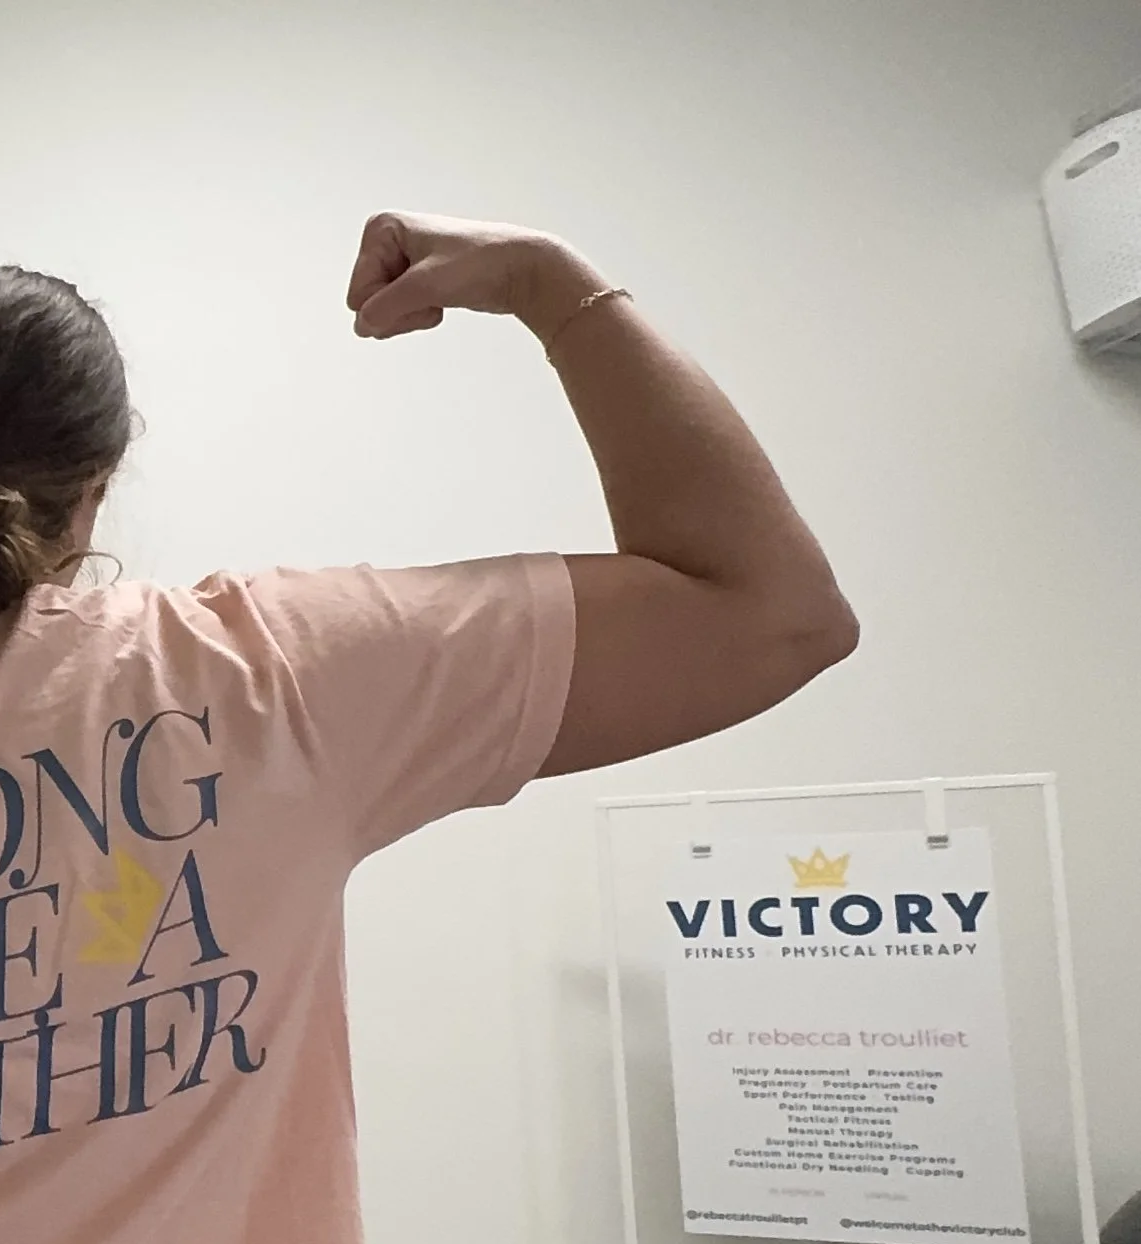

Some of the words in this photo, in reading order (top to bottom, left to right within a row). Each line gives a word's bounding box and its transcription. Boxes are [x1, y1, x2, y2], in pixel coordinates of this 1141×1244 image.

[126, 849, 229, 987] A
[665, 891, 990, 939] VICTORY
[684, 947, 756, 960] FITNESS
[781, 945, 877, 959] PHYSICAL
[884, 943, 978, 957] THERAPY
[748, 1028, 851, 1046] rebecca
[860, 1029, 969, 1048] troulliet
[732, 1067, 769, 1077] Injury
[774, 1067, 850, 1077] Assessment
[867, 1068, 943, 1078] Prevention
[739, 1080, 806, 1088] Pregnancy
[822, 1080, 901, 1090] Postpartum
[906, 1081, 938, 1090] Care
[743, 1090, 778, 1100] Sport
[782, 1091, 866, 1101] Performance
[884, 1093, 935, 1104] Testing
[778, 1102, 807, 1111] Pain
[812, 1103, 898, 1114] Management
[787, 1114, 839, 1124] Tactical
[843, 1116, 892, 1125] Fitness
[787, 1127, 835, 1136] Manual
[839, 1128, 893, 1139] Therapy
[765, 1137, 818, 1148] Surgical
[823, 1139, 919, 1150] Rehabilitation
[734, 1148, 781, 1158] Custom
[787, 1150, 823, 1159] Home
[828, 1151, 884, 1161] Exercise
[889, 1154, 956, 1165] Programs
[728, 1159, 797, 1170] Functional
[802, 1162, 824, 1172] Dry
[829, 1164, 889, 1176] Needling
[906, 1166, 964, 1178] Cupping
